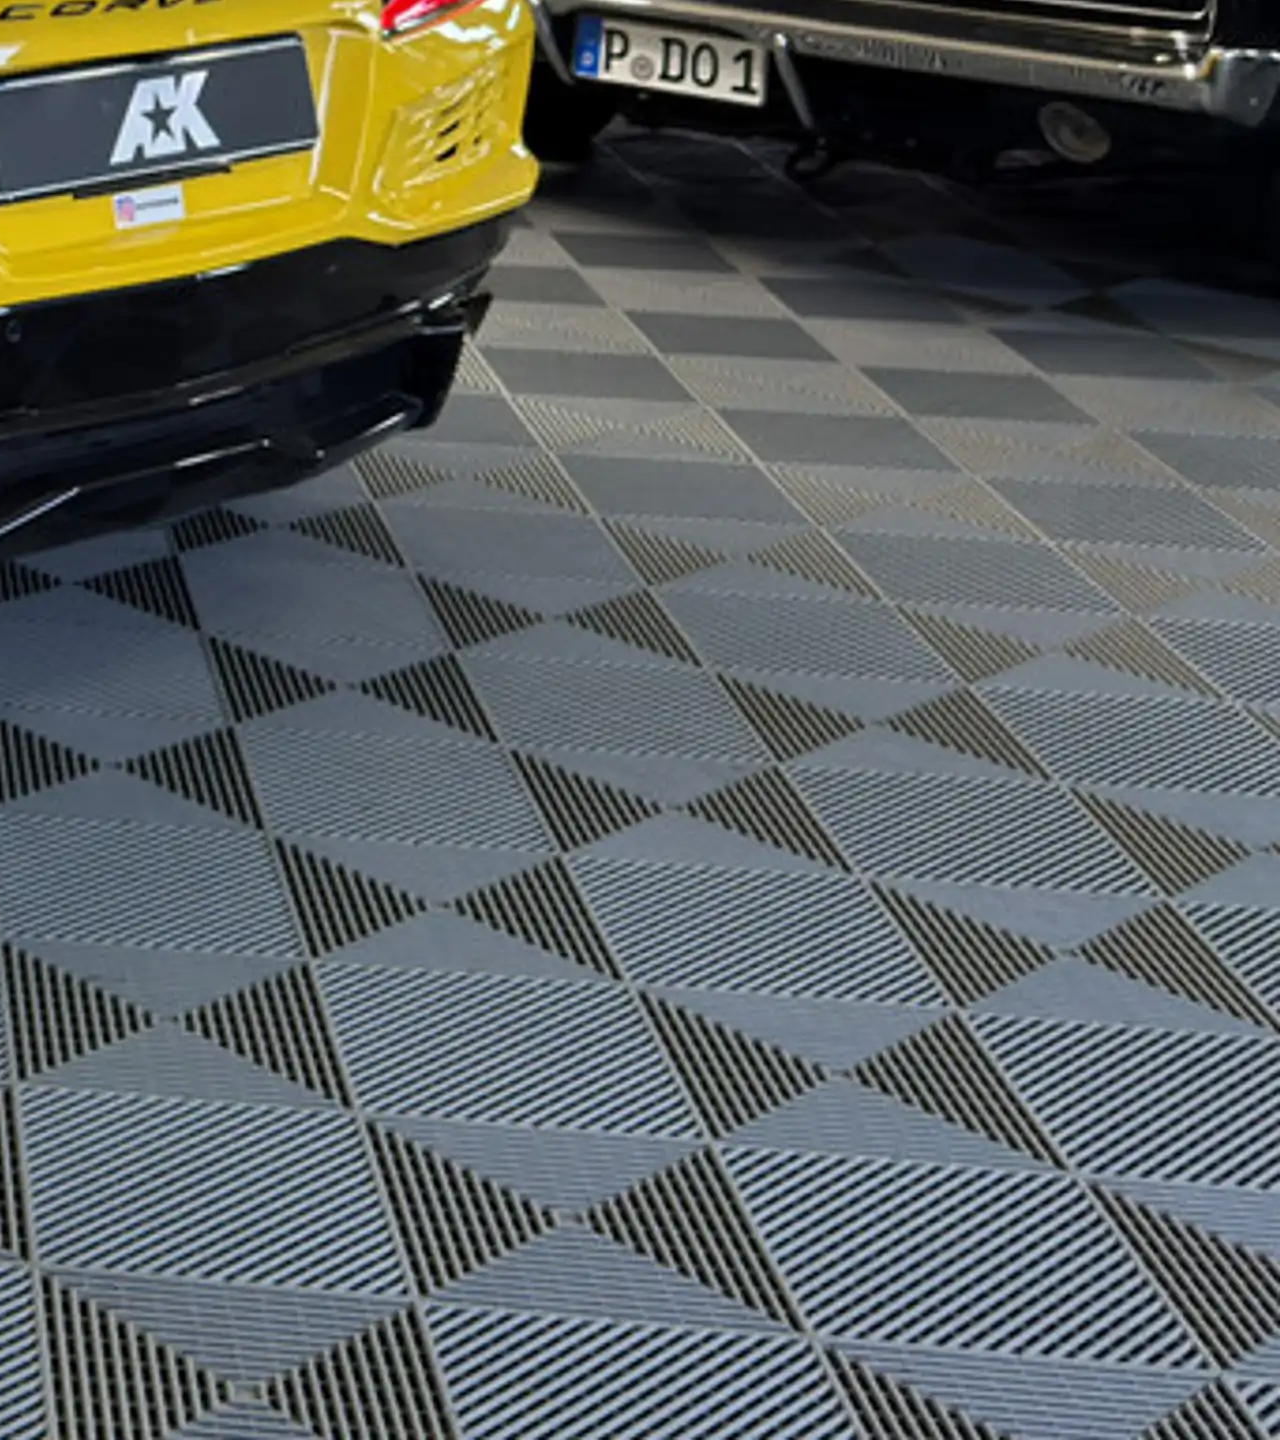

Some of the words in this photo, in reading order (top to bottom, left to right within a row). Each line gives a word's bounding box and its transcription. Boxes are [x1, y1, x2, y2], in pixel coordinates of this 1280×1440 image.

[604, 30, 630, 72] P
[659, 36, 720, 88] DO
[731, 48, 758, 96] 1
[110, 70, 221, 165] AK
